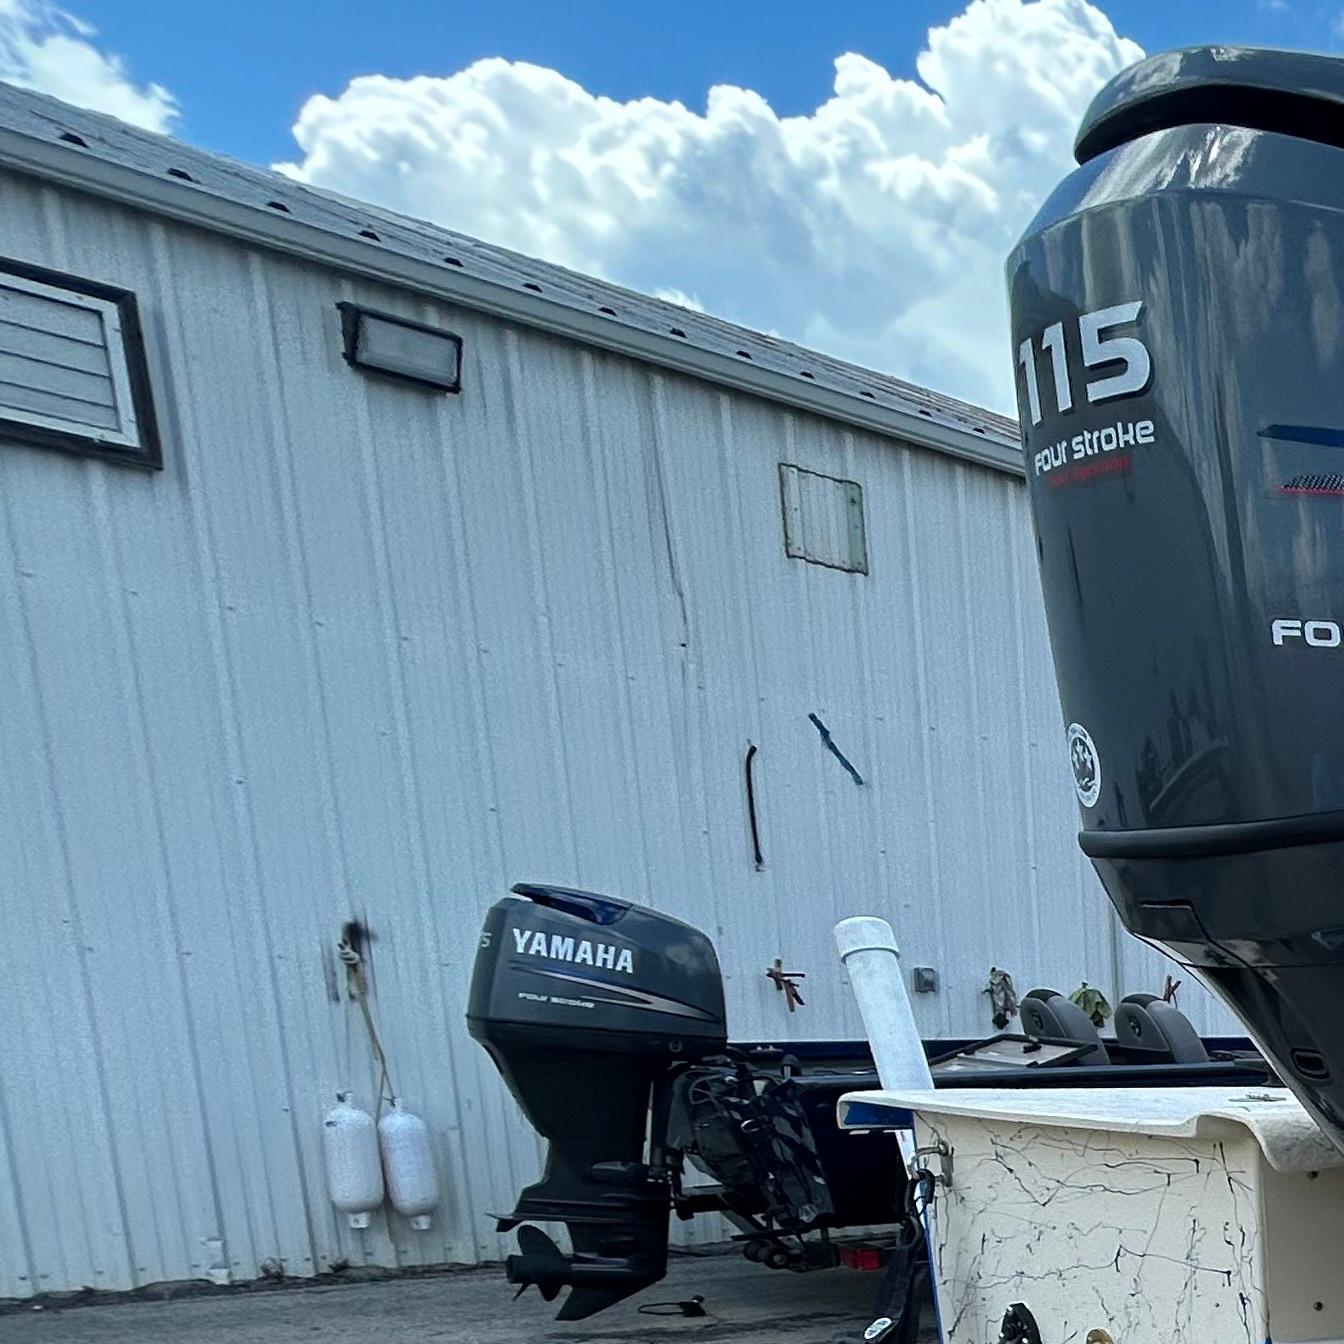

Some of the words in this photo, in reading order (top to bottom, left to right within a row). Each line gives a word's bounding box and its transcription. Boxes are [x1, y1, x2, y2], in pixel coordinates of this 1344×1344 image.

[1019, 300, 1151, 426] 115
[1034, 440, 1067, 476] Four
[1072, 420, 1155, 460] stroke
[513, 928, 634, 974] YAMAHA
